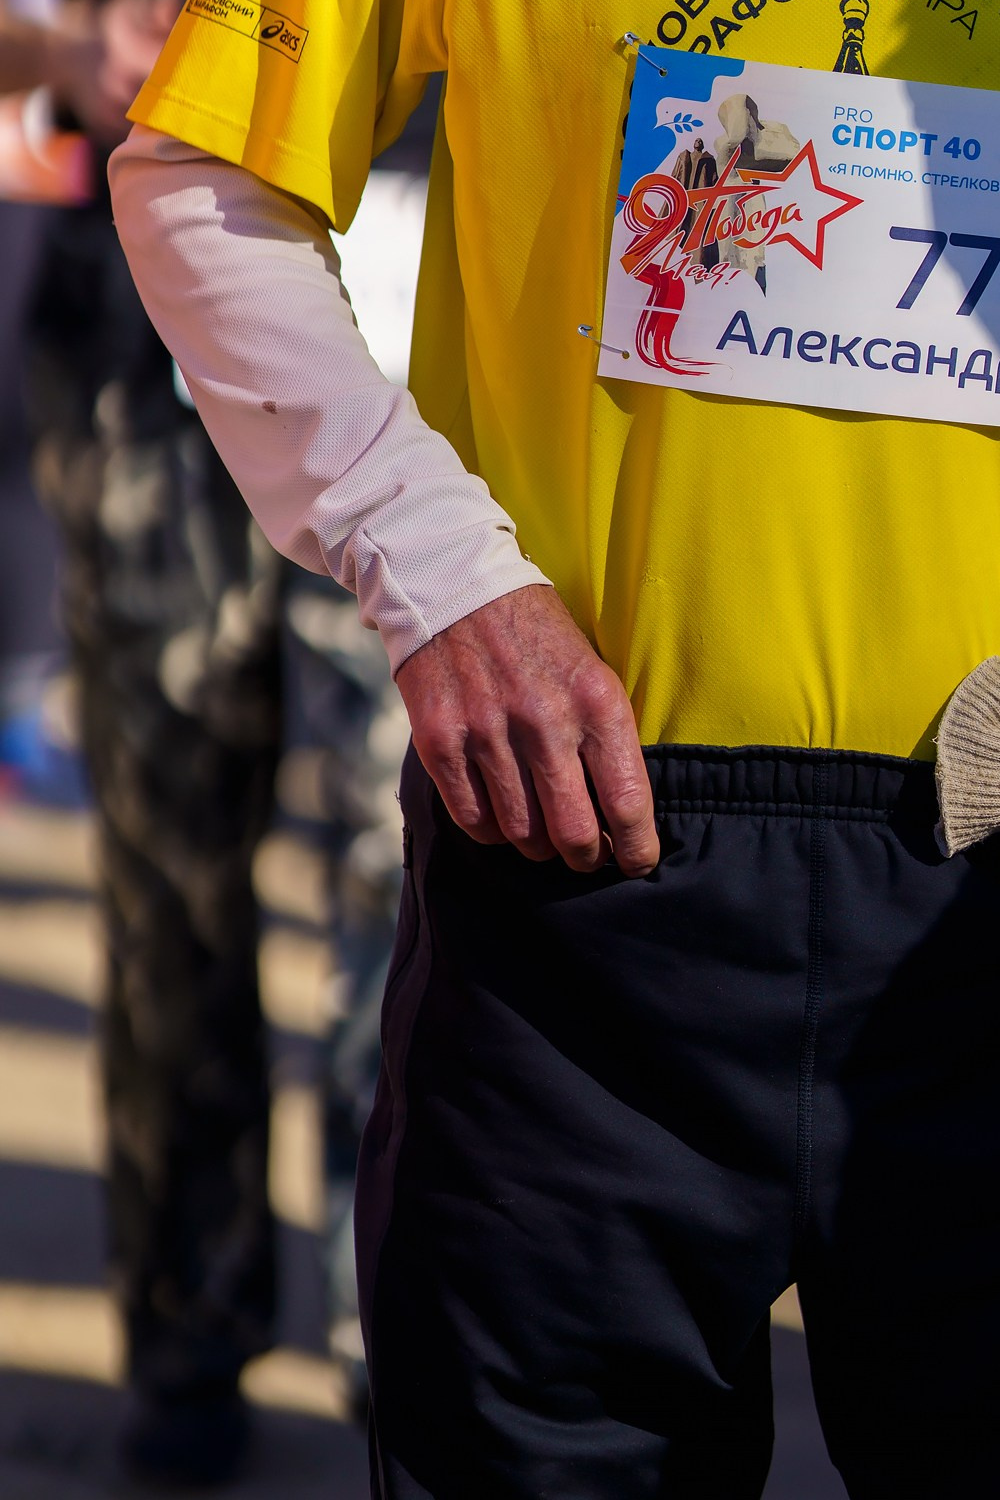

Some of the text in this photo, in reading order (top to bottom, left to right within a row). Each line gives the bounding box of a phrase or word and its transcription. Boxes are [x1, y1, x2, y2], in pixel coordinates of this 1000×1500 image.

[833, 106, 873, 123] PRO
[832, 124, 982, 161] СПОРТ 40
[828, 163, 847, 175] «Я
[851, 164, 917, 183] ПОМНЮ.
